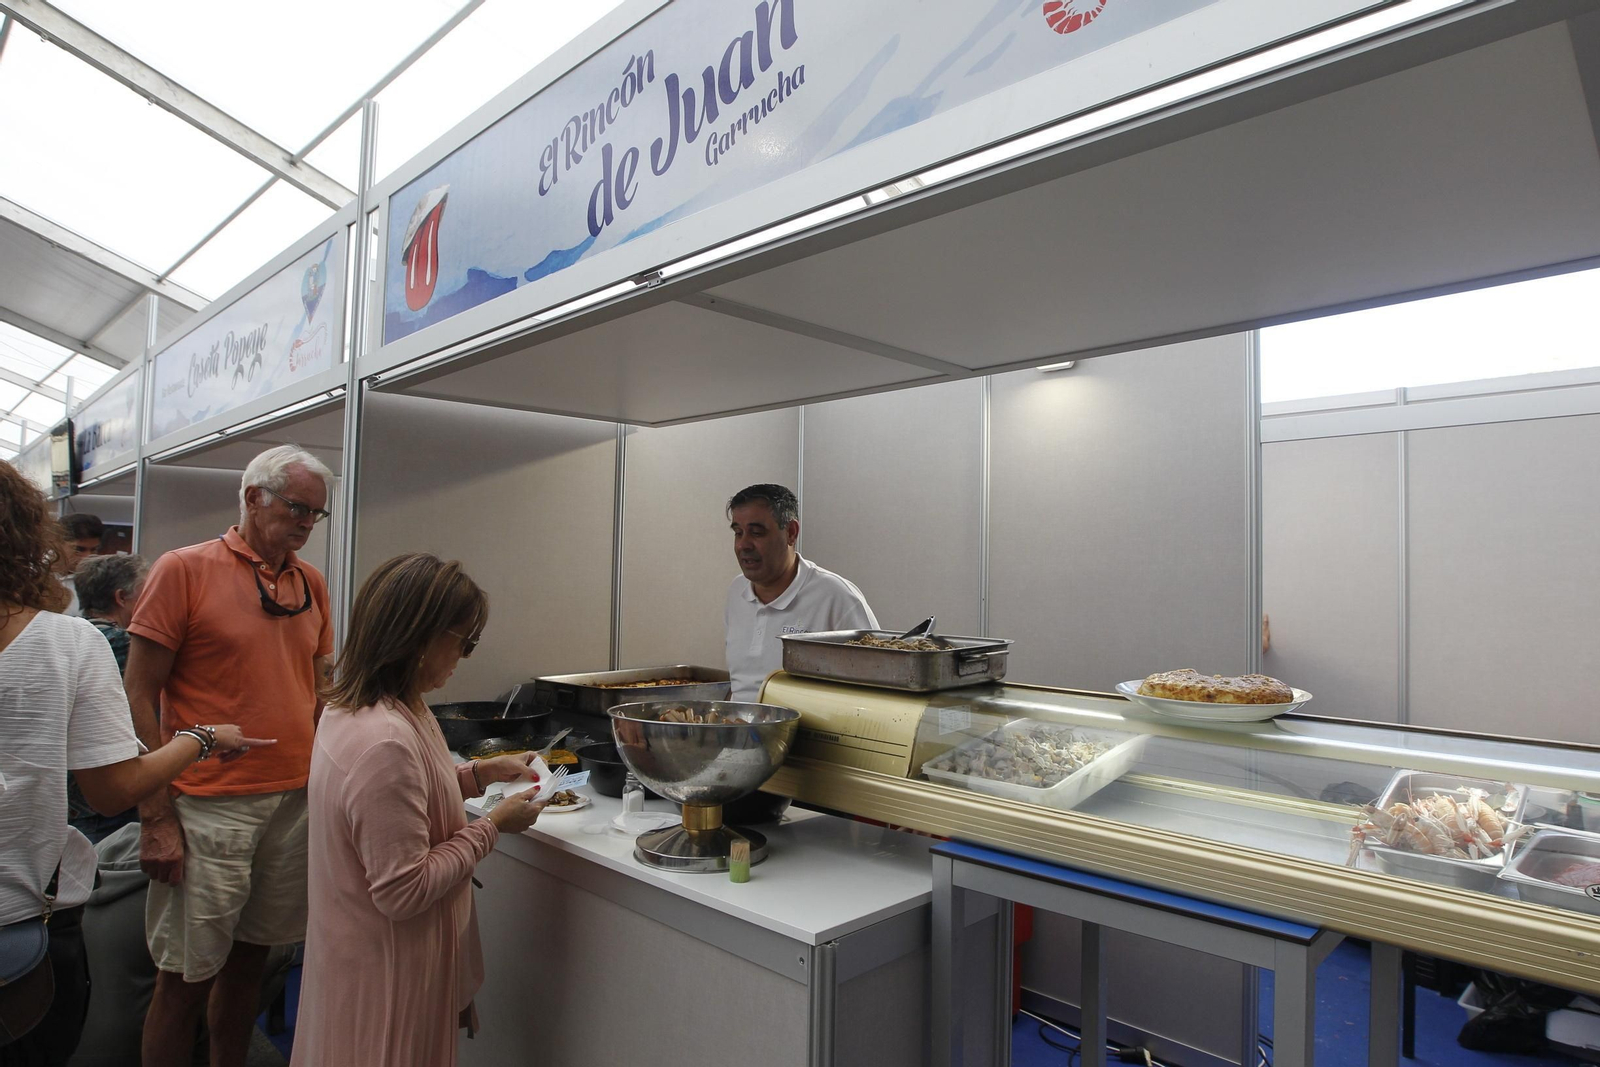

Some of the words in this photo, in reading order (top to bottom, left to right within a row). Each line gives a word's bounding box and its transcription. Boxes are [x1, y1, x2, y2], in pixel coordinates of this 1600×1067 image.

[538, 136, 559, 196] El
[560, 49, 656, 171] Rincón
[587, 142, 640, 238] de
[650, 0, 799, 177] Juan
[705, 64, 806, 167] Garrucha
[223, 322, 269, 391] Popeye
